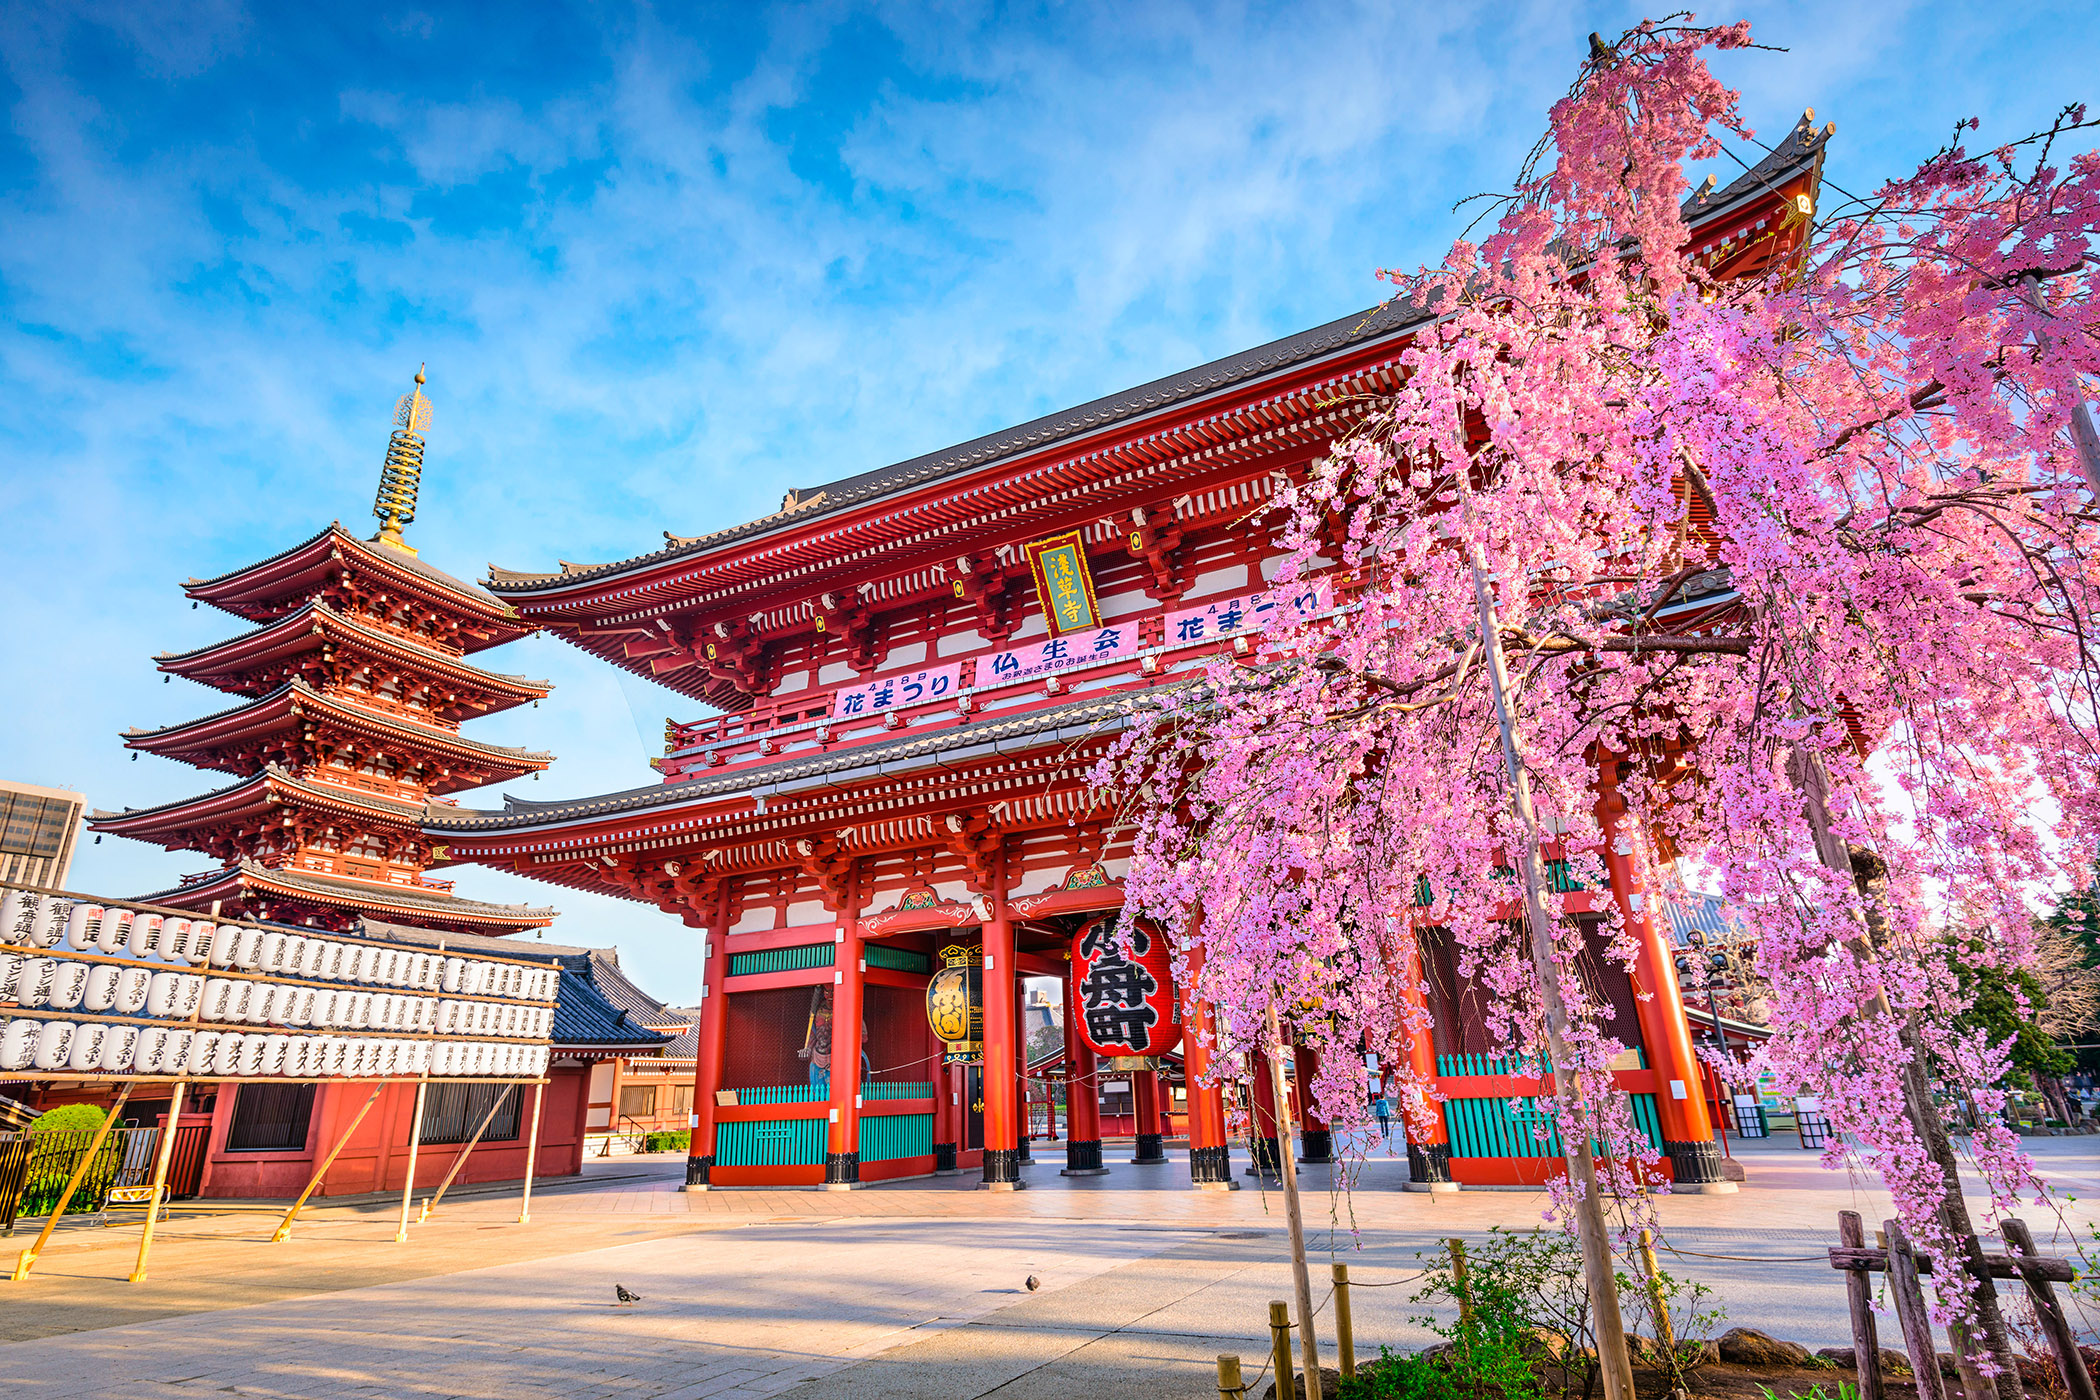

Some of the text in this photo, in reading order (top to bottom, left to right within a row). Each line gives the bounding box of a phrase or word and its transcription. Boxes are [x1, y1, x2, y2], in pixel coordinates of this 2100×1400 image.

[991, 628, 1122, 675] 仏生会
[1001, 650, 1110, 681] お釈迦さまのお誕生日
[843, 675, 949, 715] 花まつり
[868, 672, 928, 692] 4月8日
[13, 895, 39, 940] 観音通り
[46, 902, 70, 944] 観音通り
[200, 1038, 220, 1068] 米久
[226, 1040, 244, 1069] 米久
[250, 1041, 267, 1070] 米久
[273, 1041, 288, 1069] 米久
[296, 1041, 309, 1070] 米久
[313, 1042, 328, 1070] 米久
[333, 1043, 347, 1069] 米久
[352, 1044, 365, 1070] 米久
[367, 1044, 382, 1070] 米久
[385, 1044, 399, 1070] 米久
